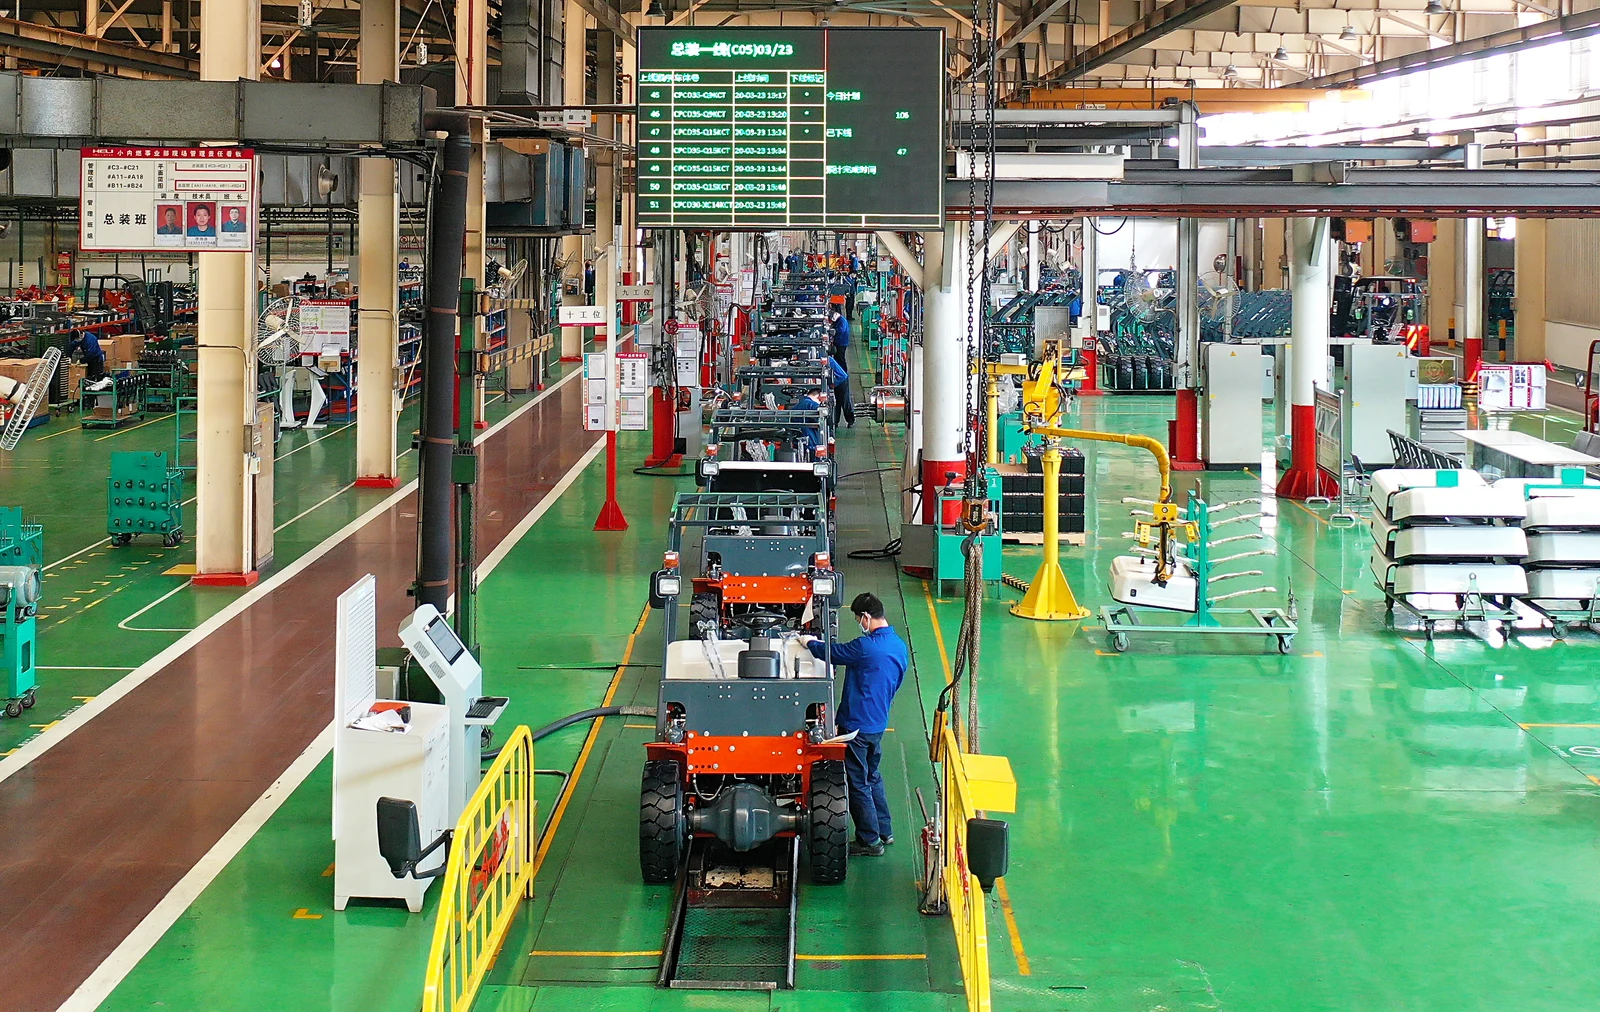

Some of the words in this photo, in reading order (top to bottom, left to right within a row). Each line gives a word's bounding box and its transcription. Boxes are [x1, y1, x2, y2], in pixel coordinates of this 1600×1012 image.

[103, 213, 147, 225] 总装班
[566, 310, 601, 319] 十工位
